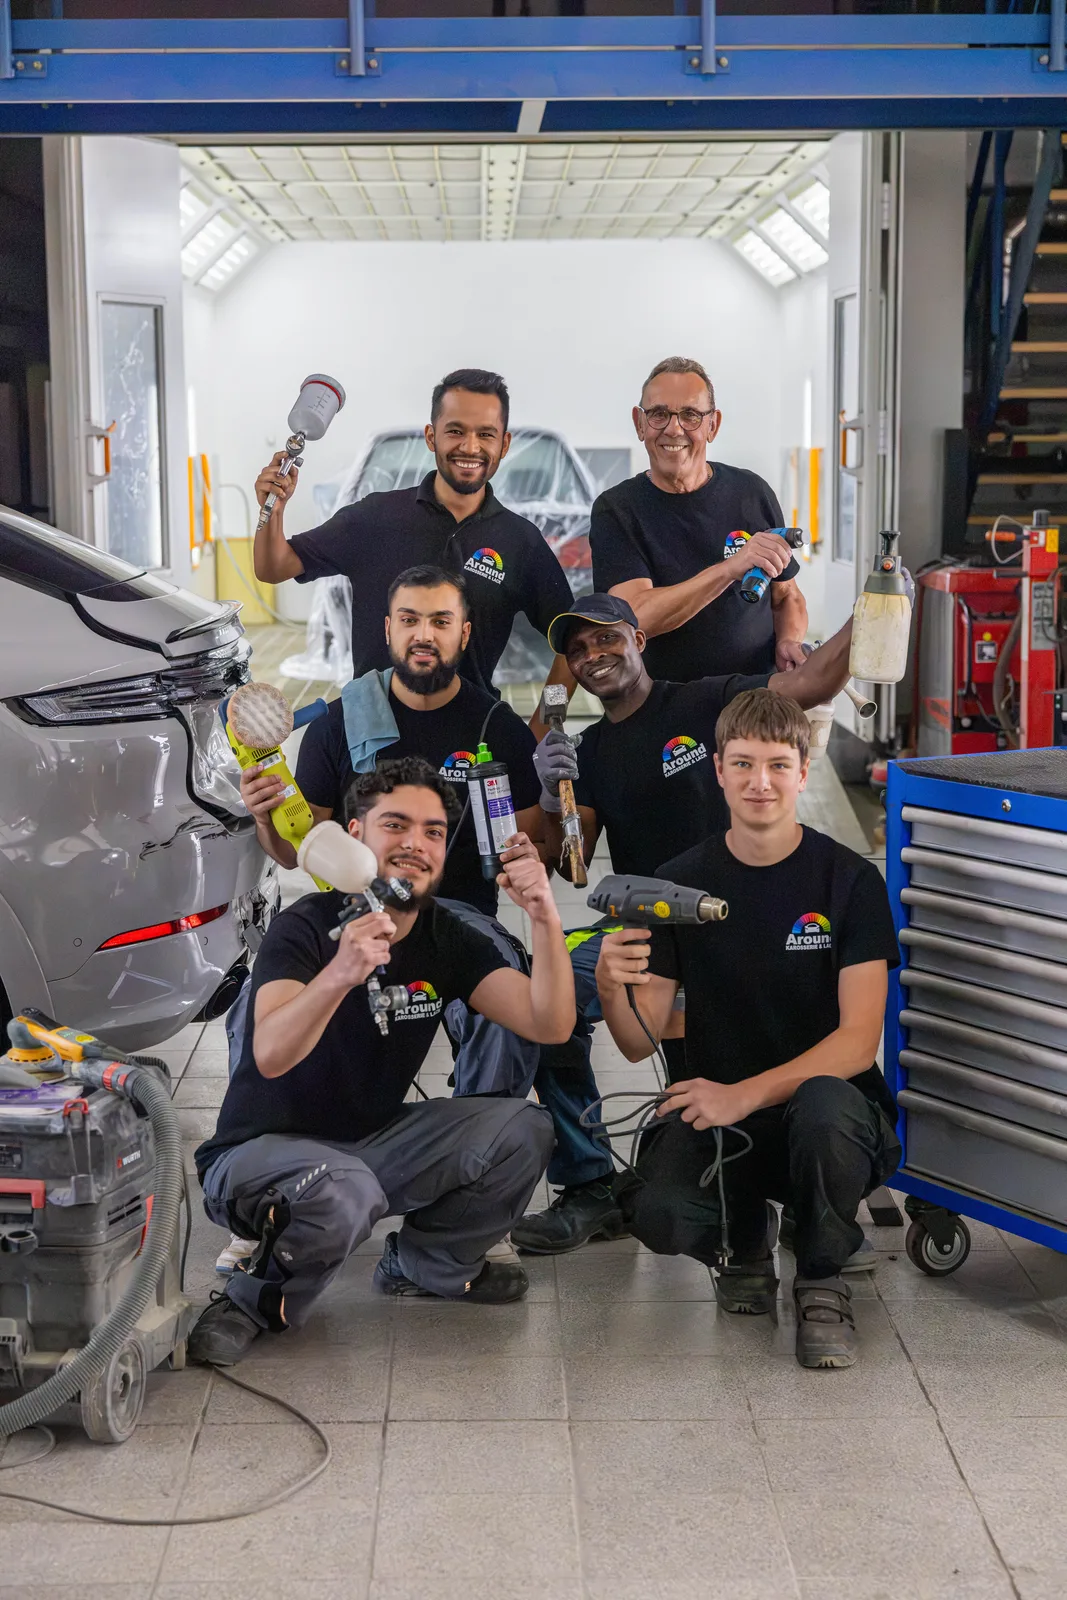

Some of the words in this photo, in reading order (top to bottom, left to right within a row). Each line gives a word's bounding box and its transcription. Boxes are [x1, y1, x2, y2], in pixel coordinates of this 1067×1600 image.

[464, 557, 506, 581] Around
[662, 743, 707, 774] Around
[438, 766, 467, 778] Arou
[664, 762, 692, 778] KAROSSERIE
[486, 779, 498, 787] 3M
[785, 933, 832, 946] Aroun
[394, 997, 443, 1017] Around
